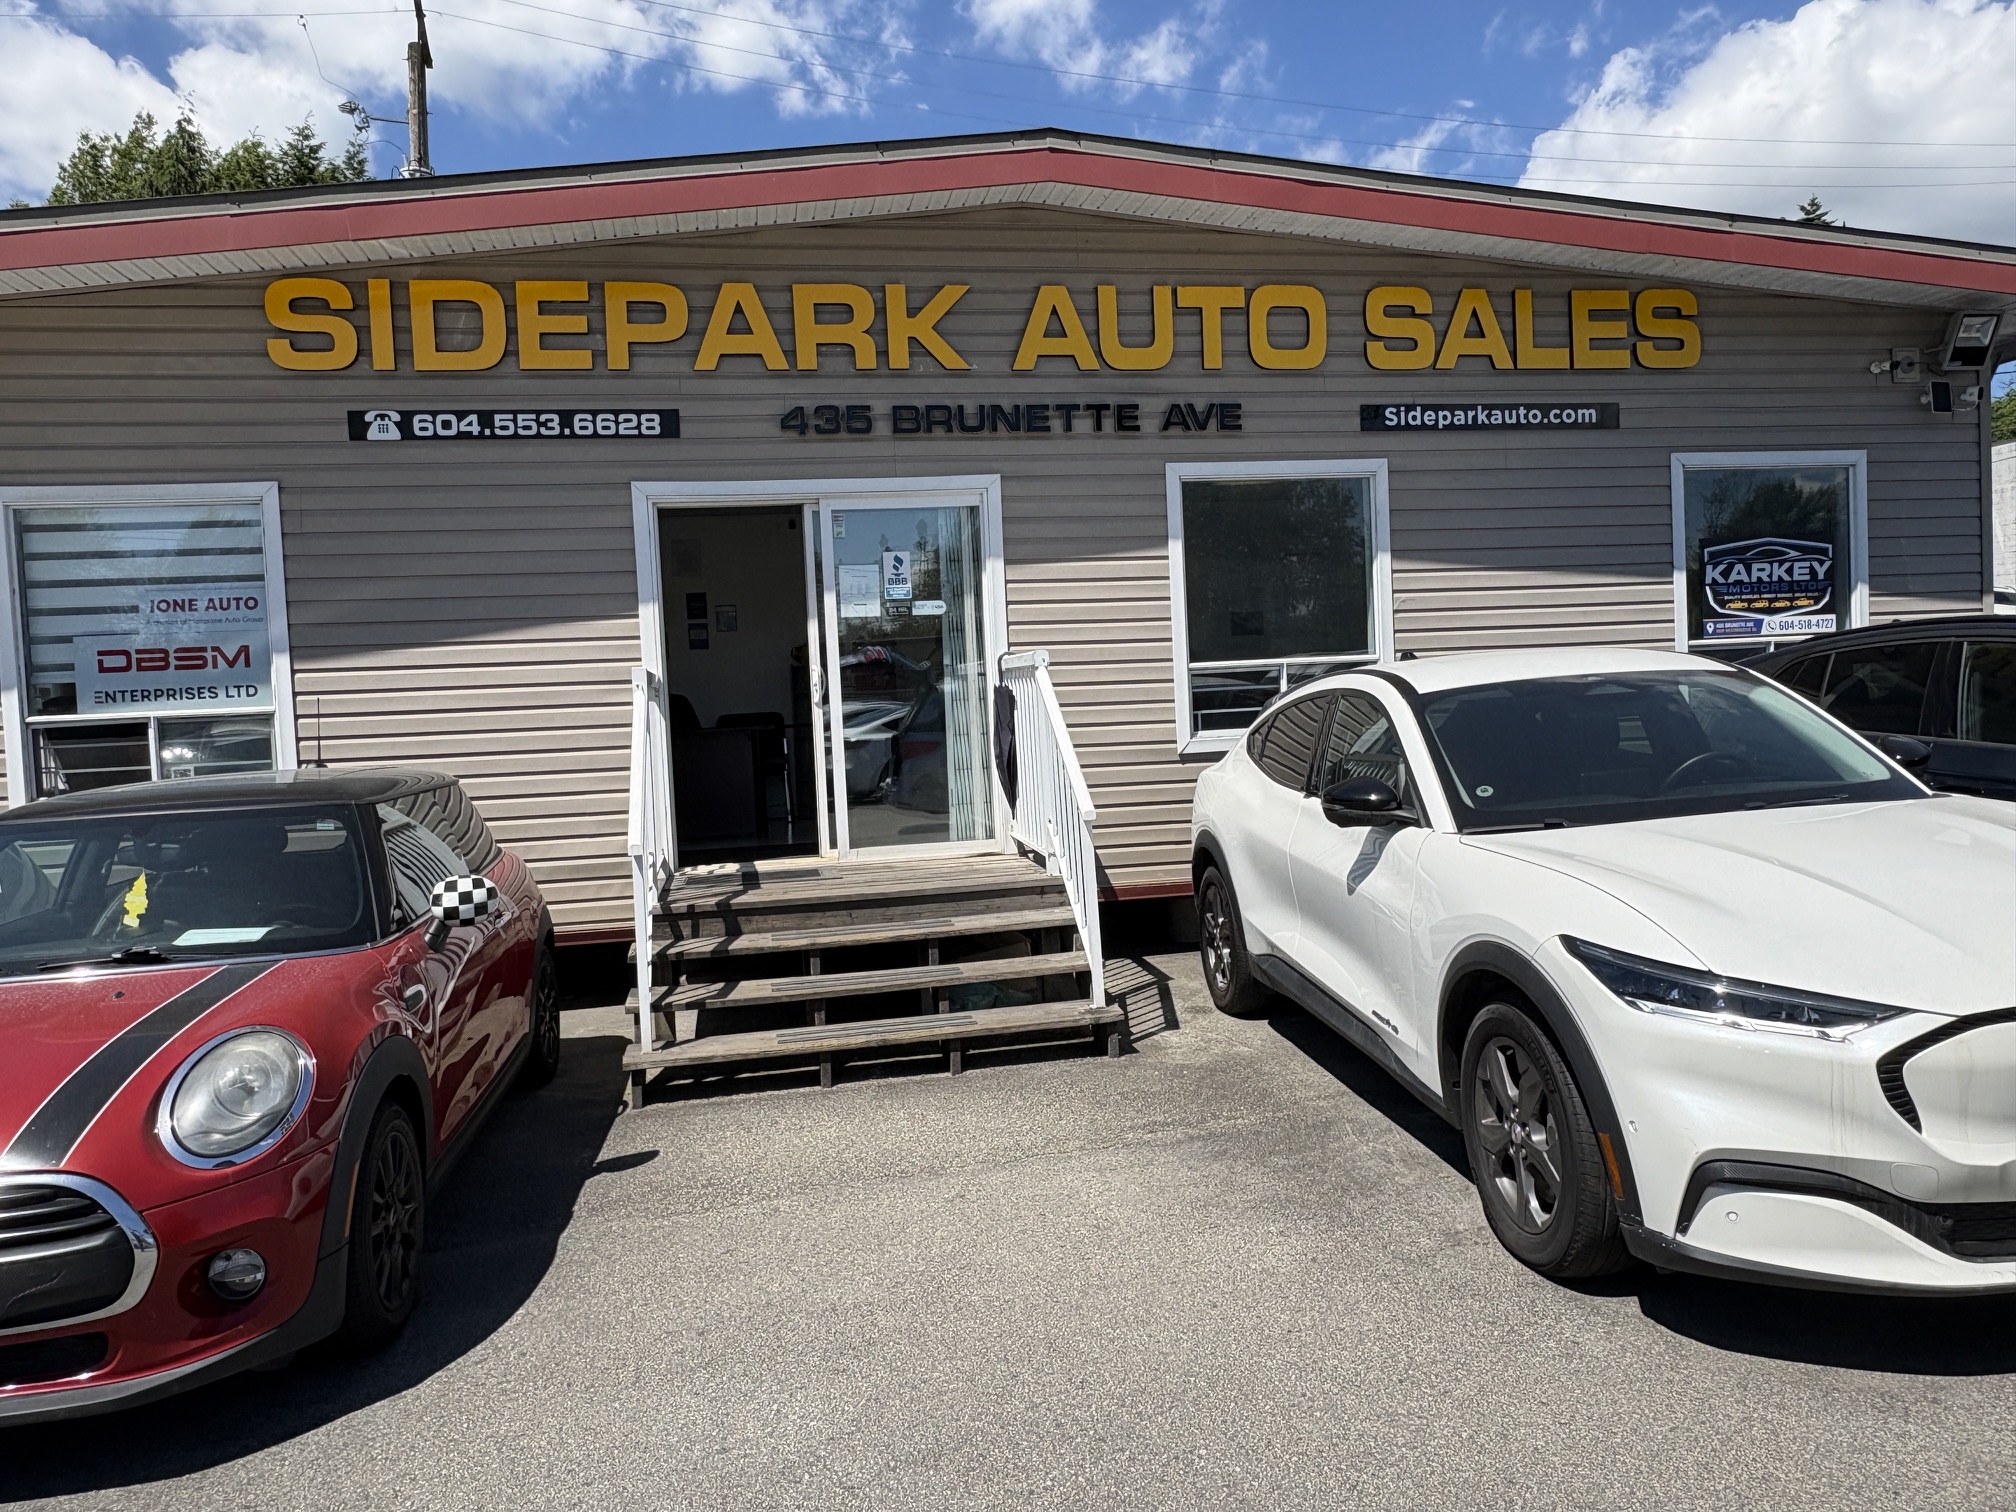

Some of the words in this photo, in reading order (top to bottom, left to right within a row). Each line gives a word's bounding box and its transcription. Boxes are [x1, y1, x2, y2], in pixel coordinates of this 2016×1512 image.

[263, 277, 971, 373] SIDEPARK
[1012, 284, 1328, 373] AUTO
[1364, 286, 1702, 372] SALES
[412, 413, 661, 437] 604.553.6628
[780, 404, 872, 435] 435
[891, 403, 1142, 434] BRUNETTE
[1160, 402, 1244, 432] AVE
[1384, 405, 1597, 429] Sideparkauto.com
[888, 577, 908, 586] BBB
[1705, 560, 1833, 584] KARKEY
[1728, 582, 1789, 594] MOTORS
[1793, 580, 1819, 591] LTD
[204, 596, 259, 612] AUTO
[1778, 618, 1834, 631] 604-518-4727
[96, 644, 251, 674] DBSM
[94, 685, 219, 704] ENTERPRISES
[225, 684, 259, 699] LTD
